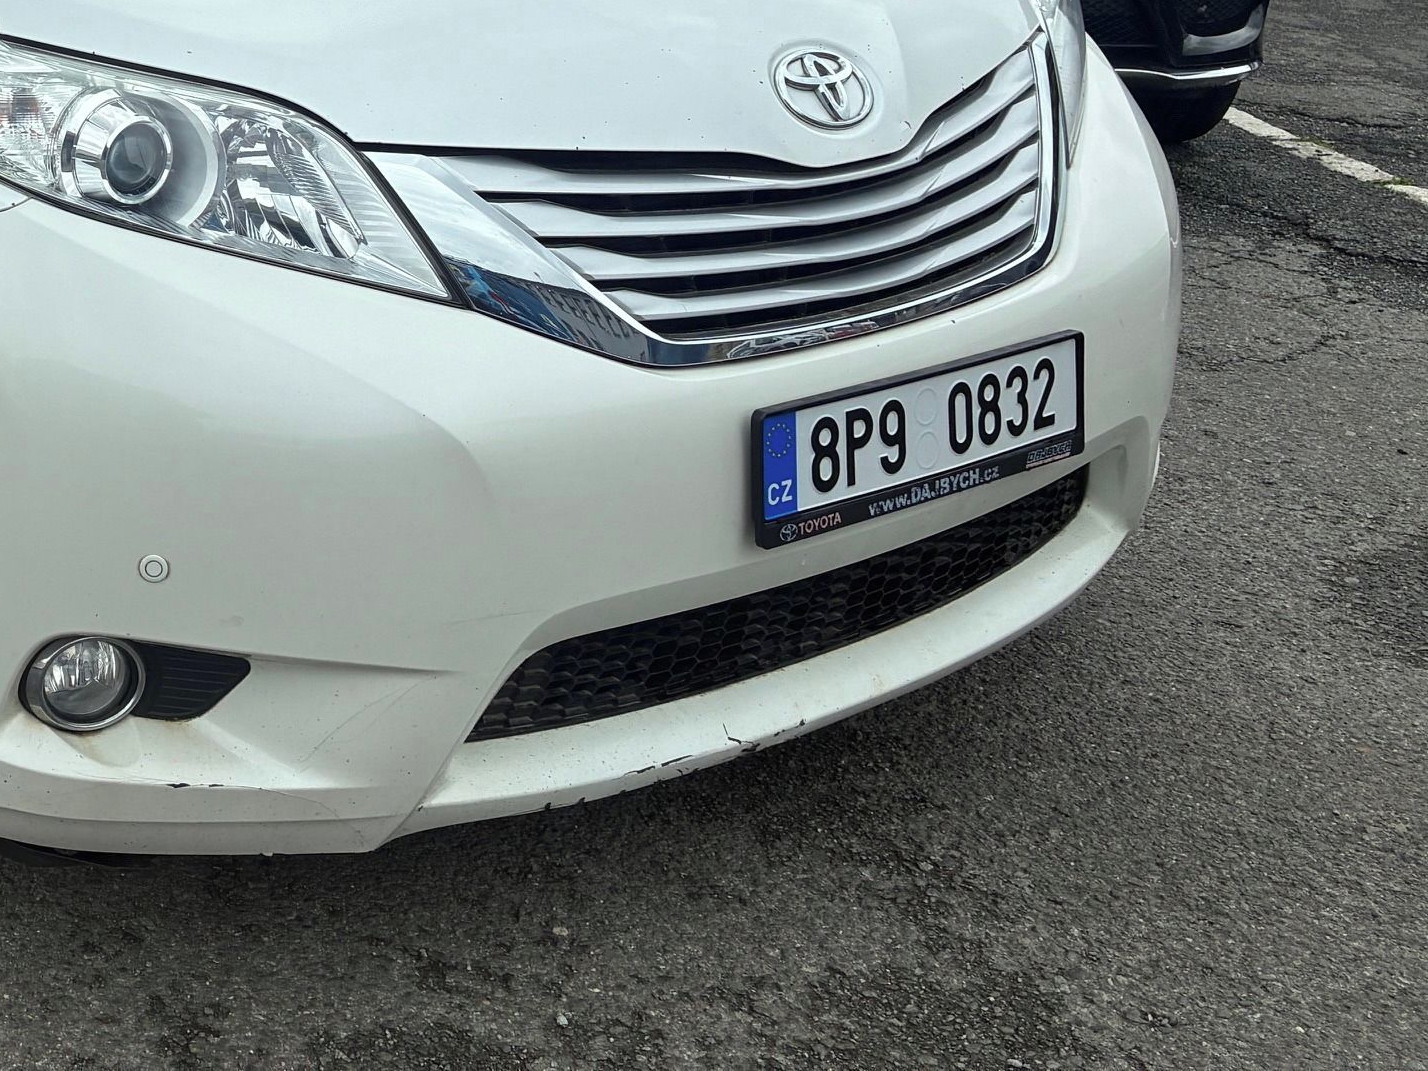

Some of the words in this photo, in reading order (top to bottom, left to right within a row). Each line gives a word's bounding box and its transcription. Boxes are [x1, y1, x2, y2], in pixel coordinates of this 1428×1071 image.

[810, 398, 907, 493] 8P9
[947, 357, 1056, 455] 0832
[768, 479, 793, 506] CZ
[868, 465, 1000, 516] www.DAJBYCH.cz
[798, 512, 842, 535] TOYOTA
